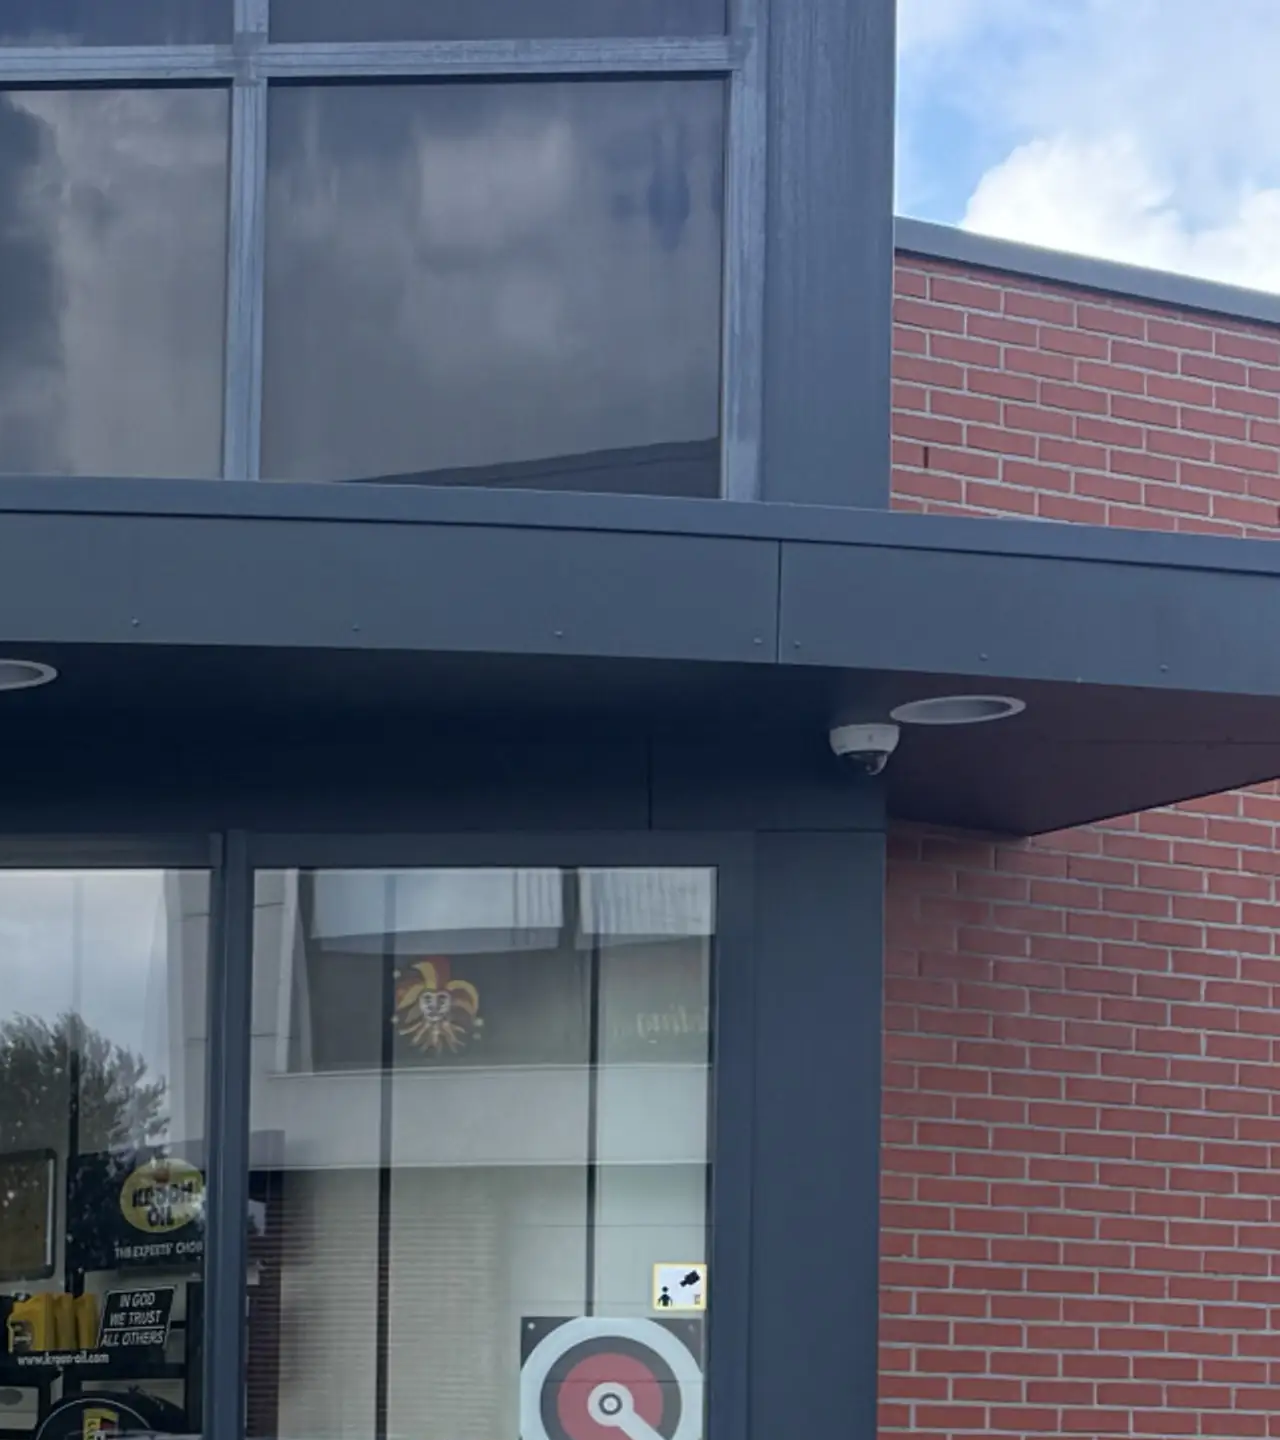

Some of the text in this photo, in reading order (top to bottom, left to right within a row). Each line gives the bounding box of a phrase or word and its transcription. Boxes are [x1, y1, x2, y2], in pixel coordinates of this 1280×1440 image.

[120, 1292, 156, 1308] IN GOD
[128, 1310, 163, 1325] TRUST
[122, 1330, 165, 1346] OTHERS
